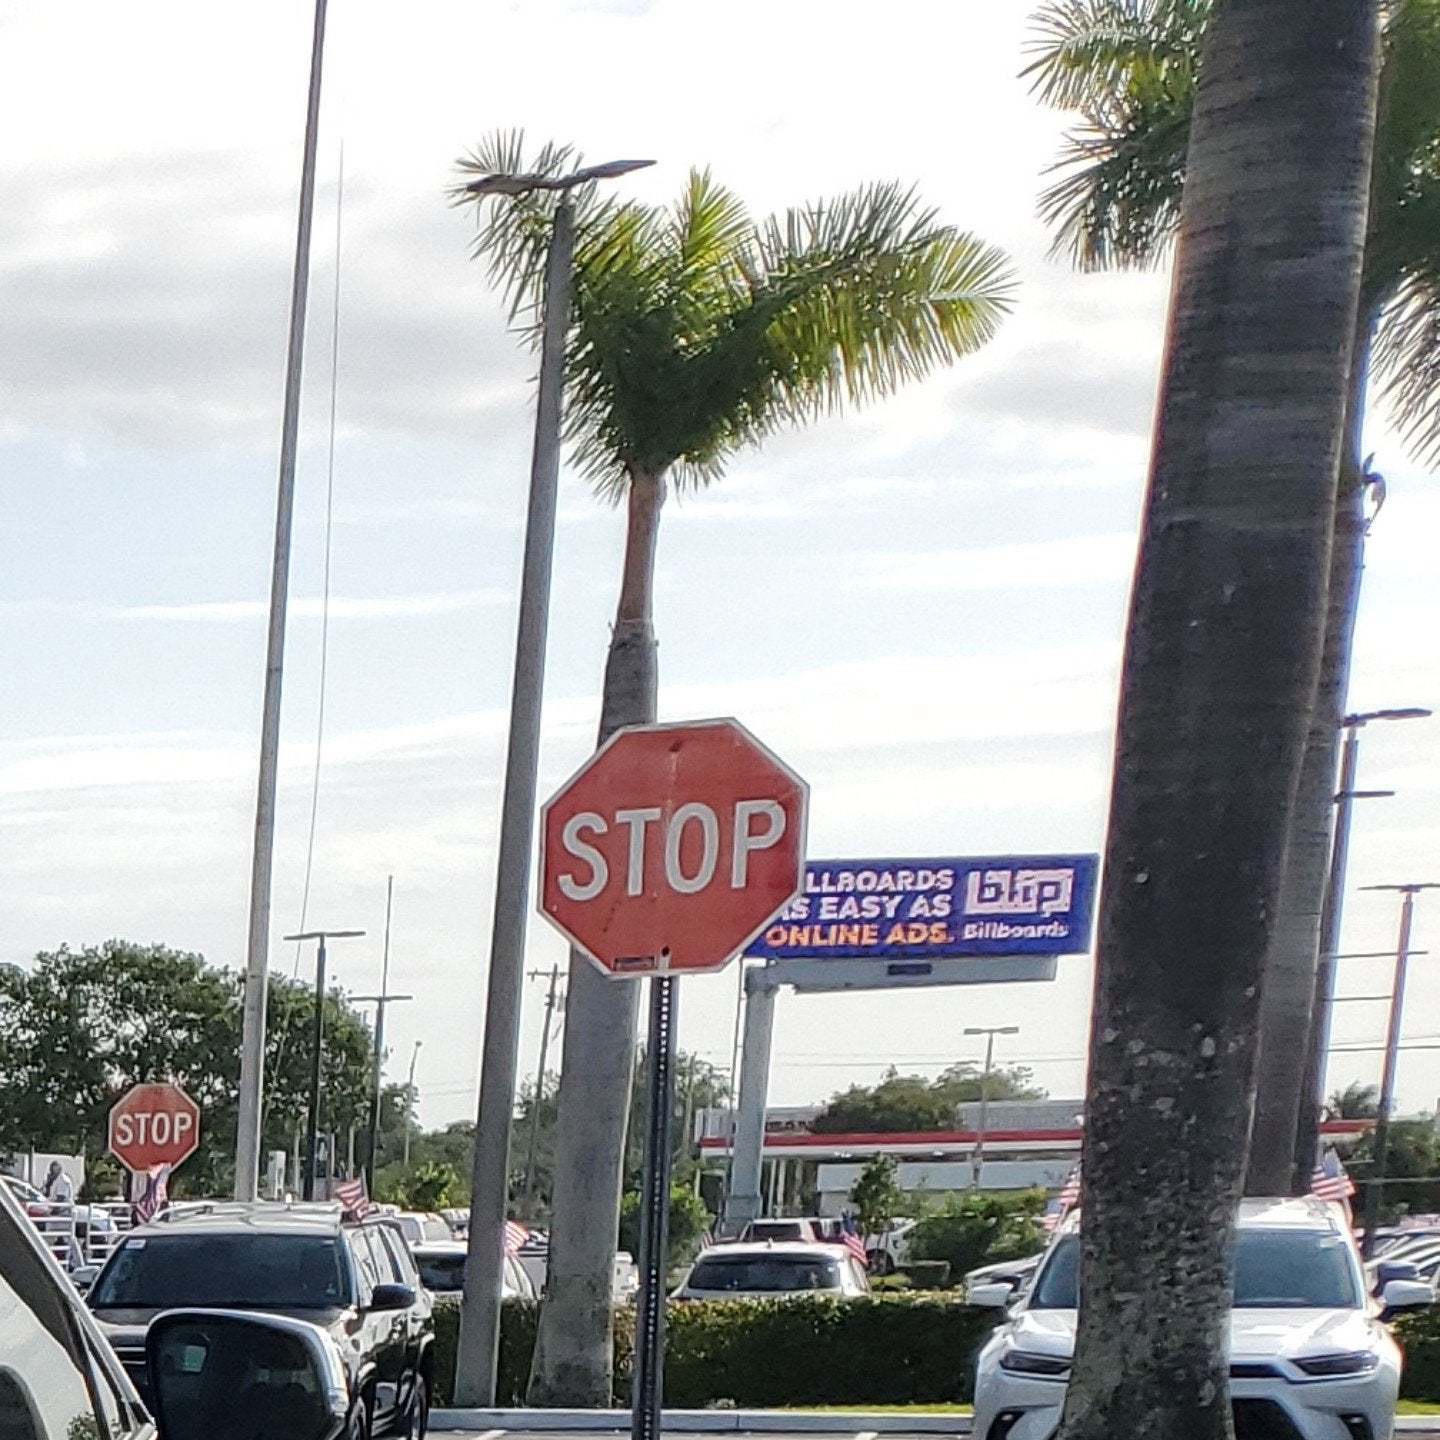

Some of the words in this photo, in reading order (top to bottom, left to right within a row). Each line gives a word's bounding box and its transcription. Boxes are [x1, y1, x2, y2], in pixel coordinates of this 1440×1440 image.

[557, 799, 787, 901] STOP
[806, 869, 954, 894] LLBOARDS
[819, 895, 903, 920] EASY
[909, 894, 953, 918] AS
[765, 923, 879, 947] ONLINE
[886, 922, 955, 945] ADS.
[964, 921, 1069, 940] Billboards
[115, 1112, 193, 1146] STOP
